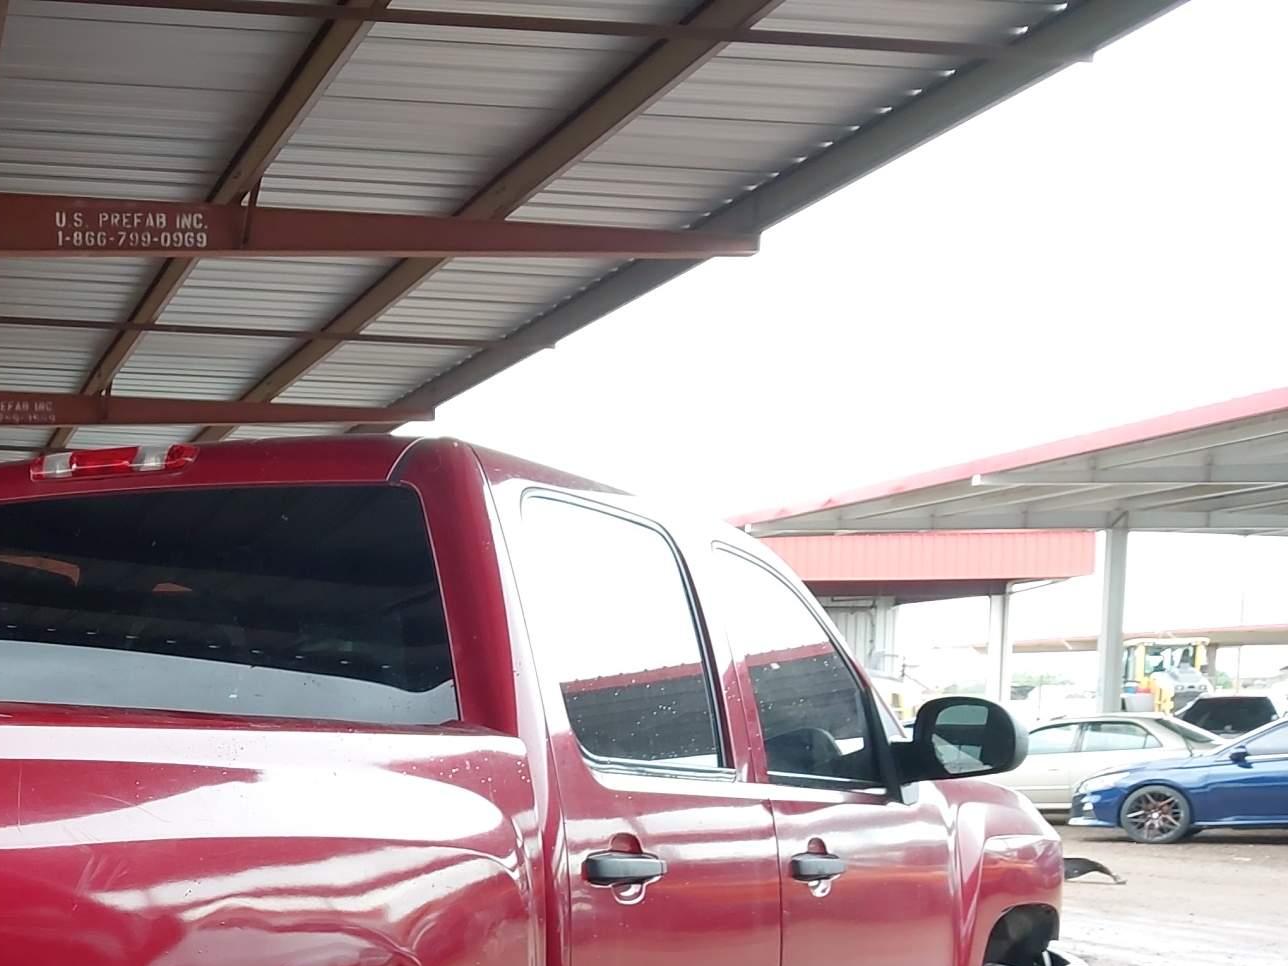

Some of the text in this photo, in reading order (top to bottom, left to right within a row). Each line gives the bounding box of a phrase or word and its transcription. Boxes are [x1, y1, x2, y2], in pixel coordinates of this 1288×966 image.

[99, 212, 167, 228] PREFAB
[176, 213, 209, 229] INC.
[57, 230, 207, 247] 1-866-799-0969
